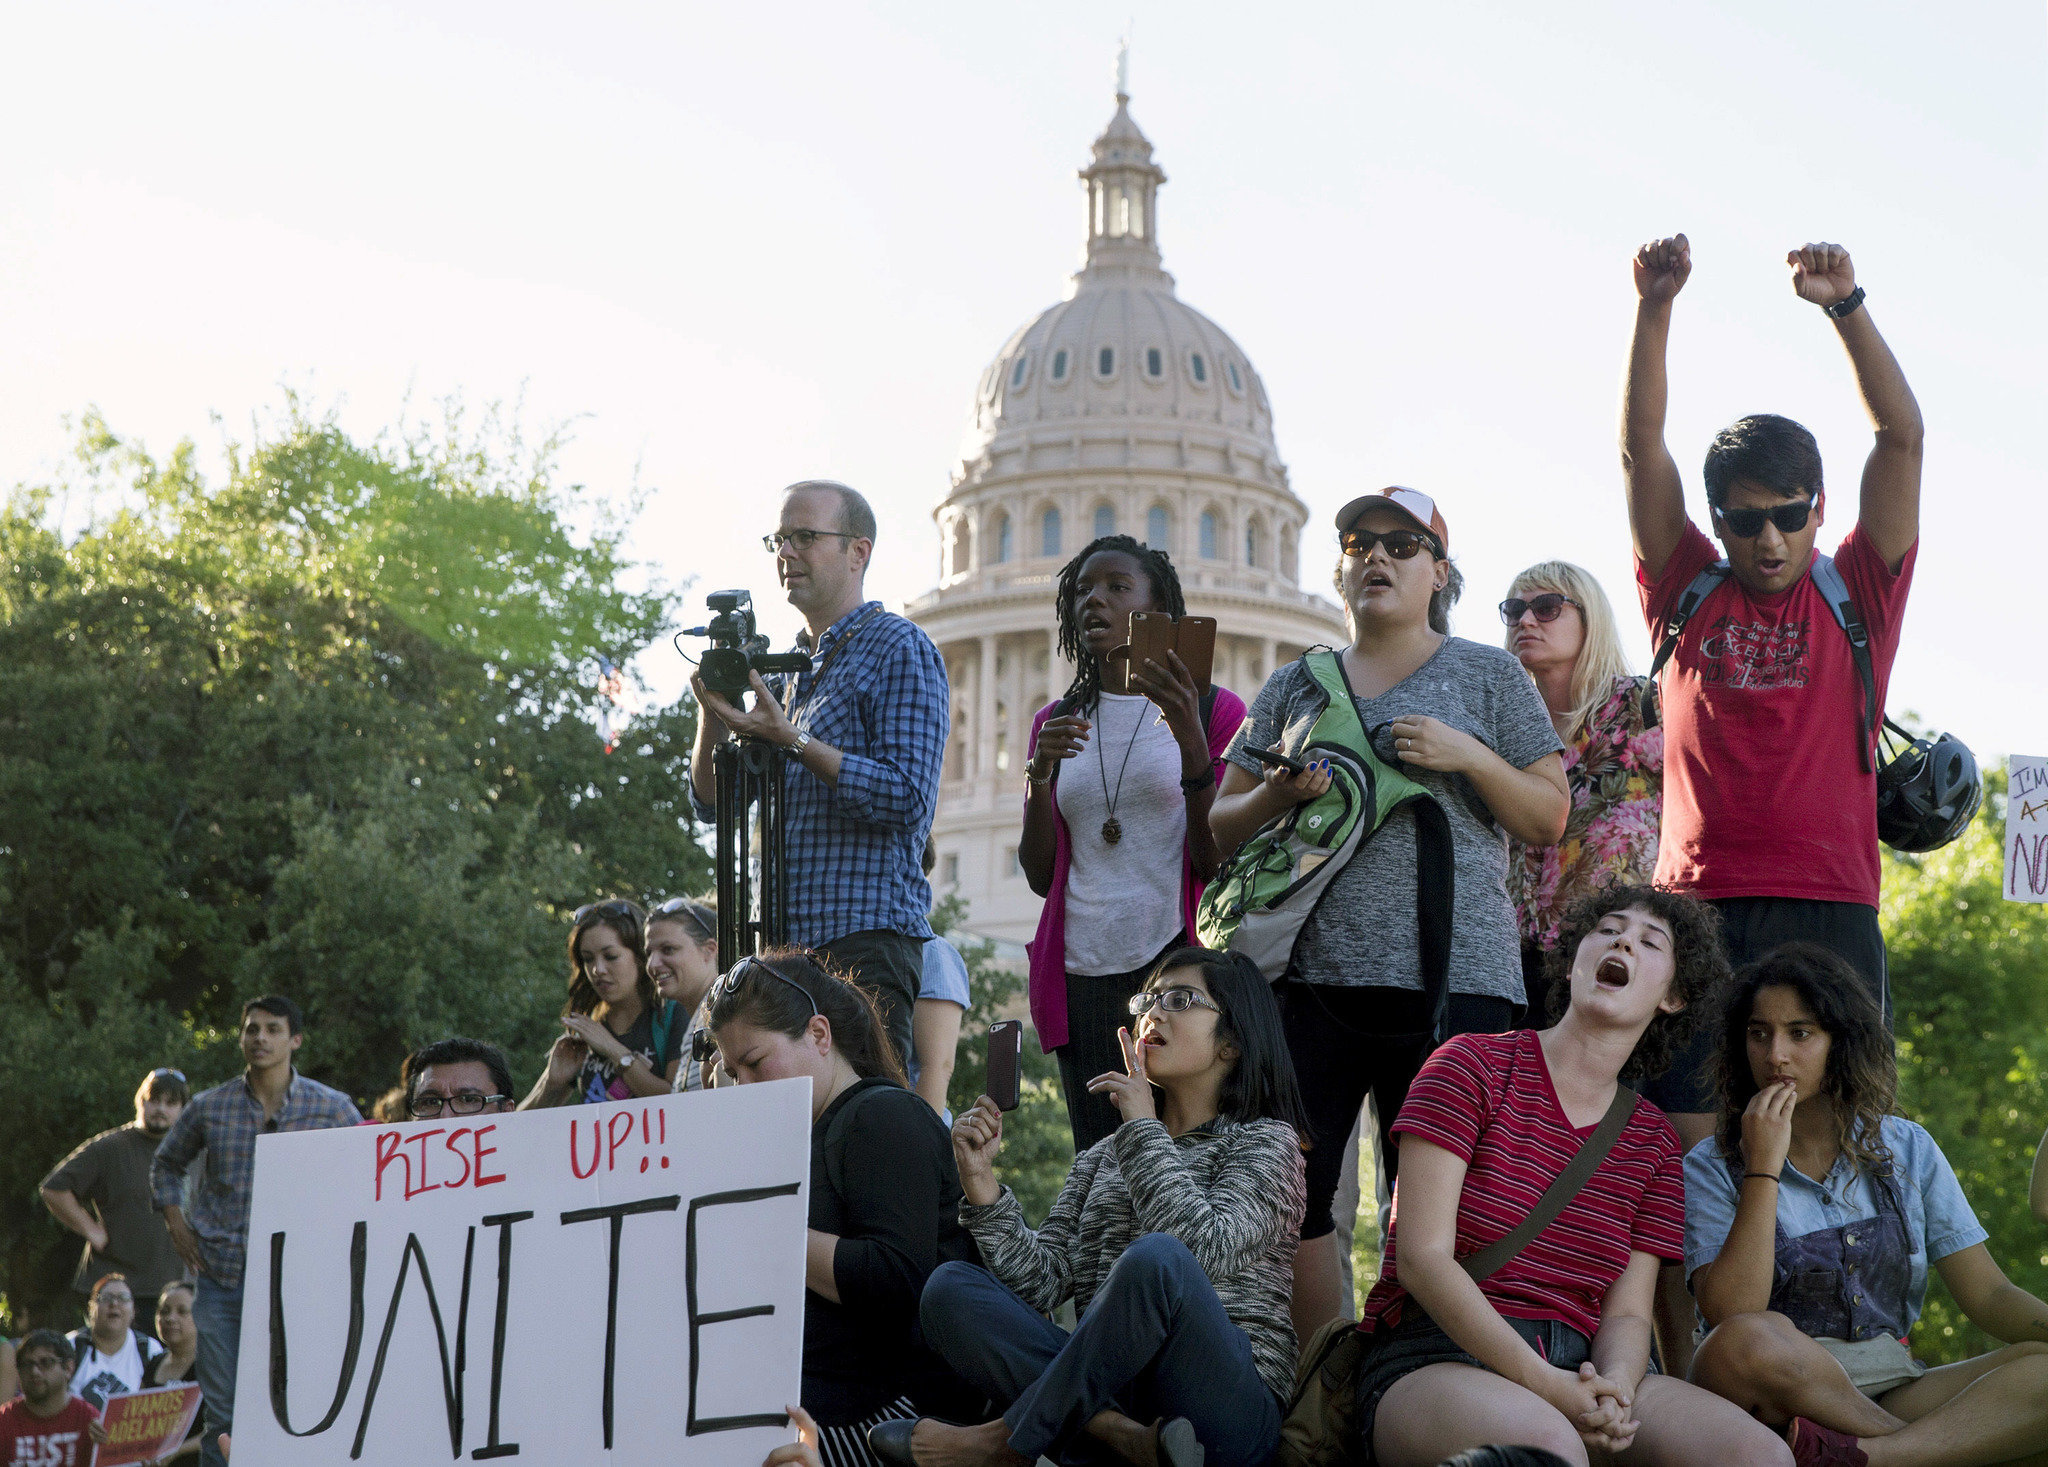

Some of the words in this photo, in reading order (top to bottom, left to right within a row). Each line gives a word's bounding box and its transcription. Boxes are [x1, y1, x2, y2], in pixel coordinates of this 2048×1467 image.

[374, 1124, 506, 1202] RISE
[570, 1107, 671, 1179] UP!!
[269, 1182, 800, 1461] UNITE
